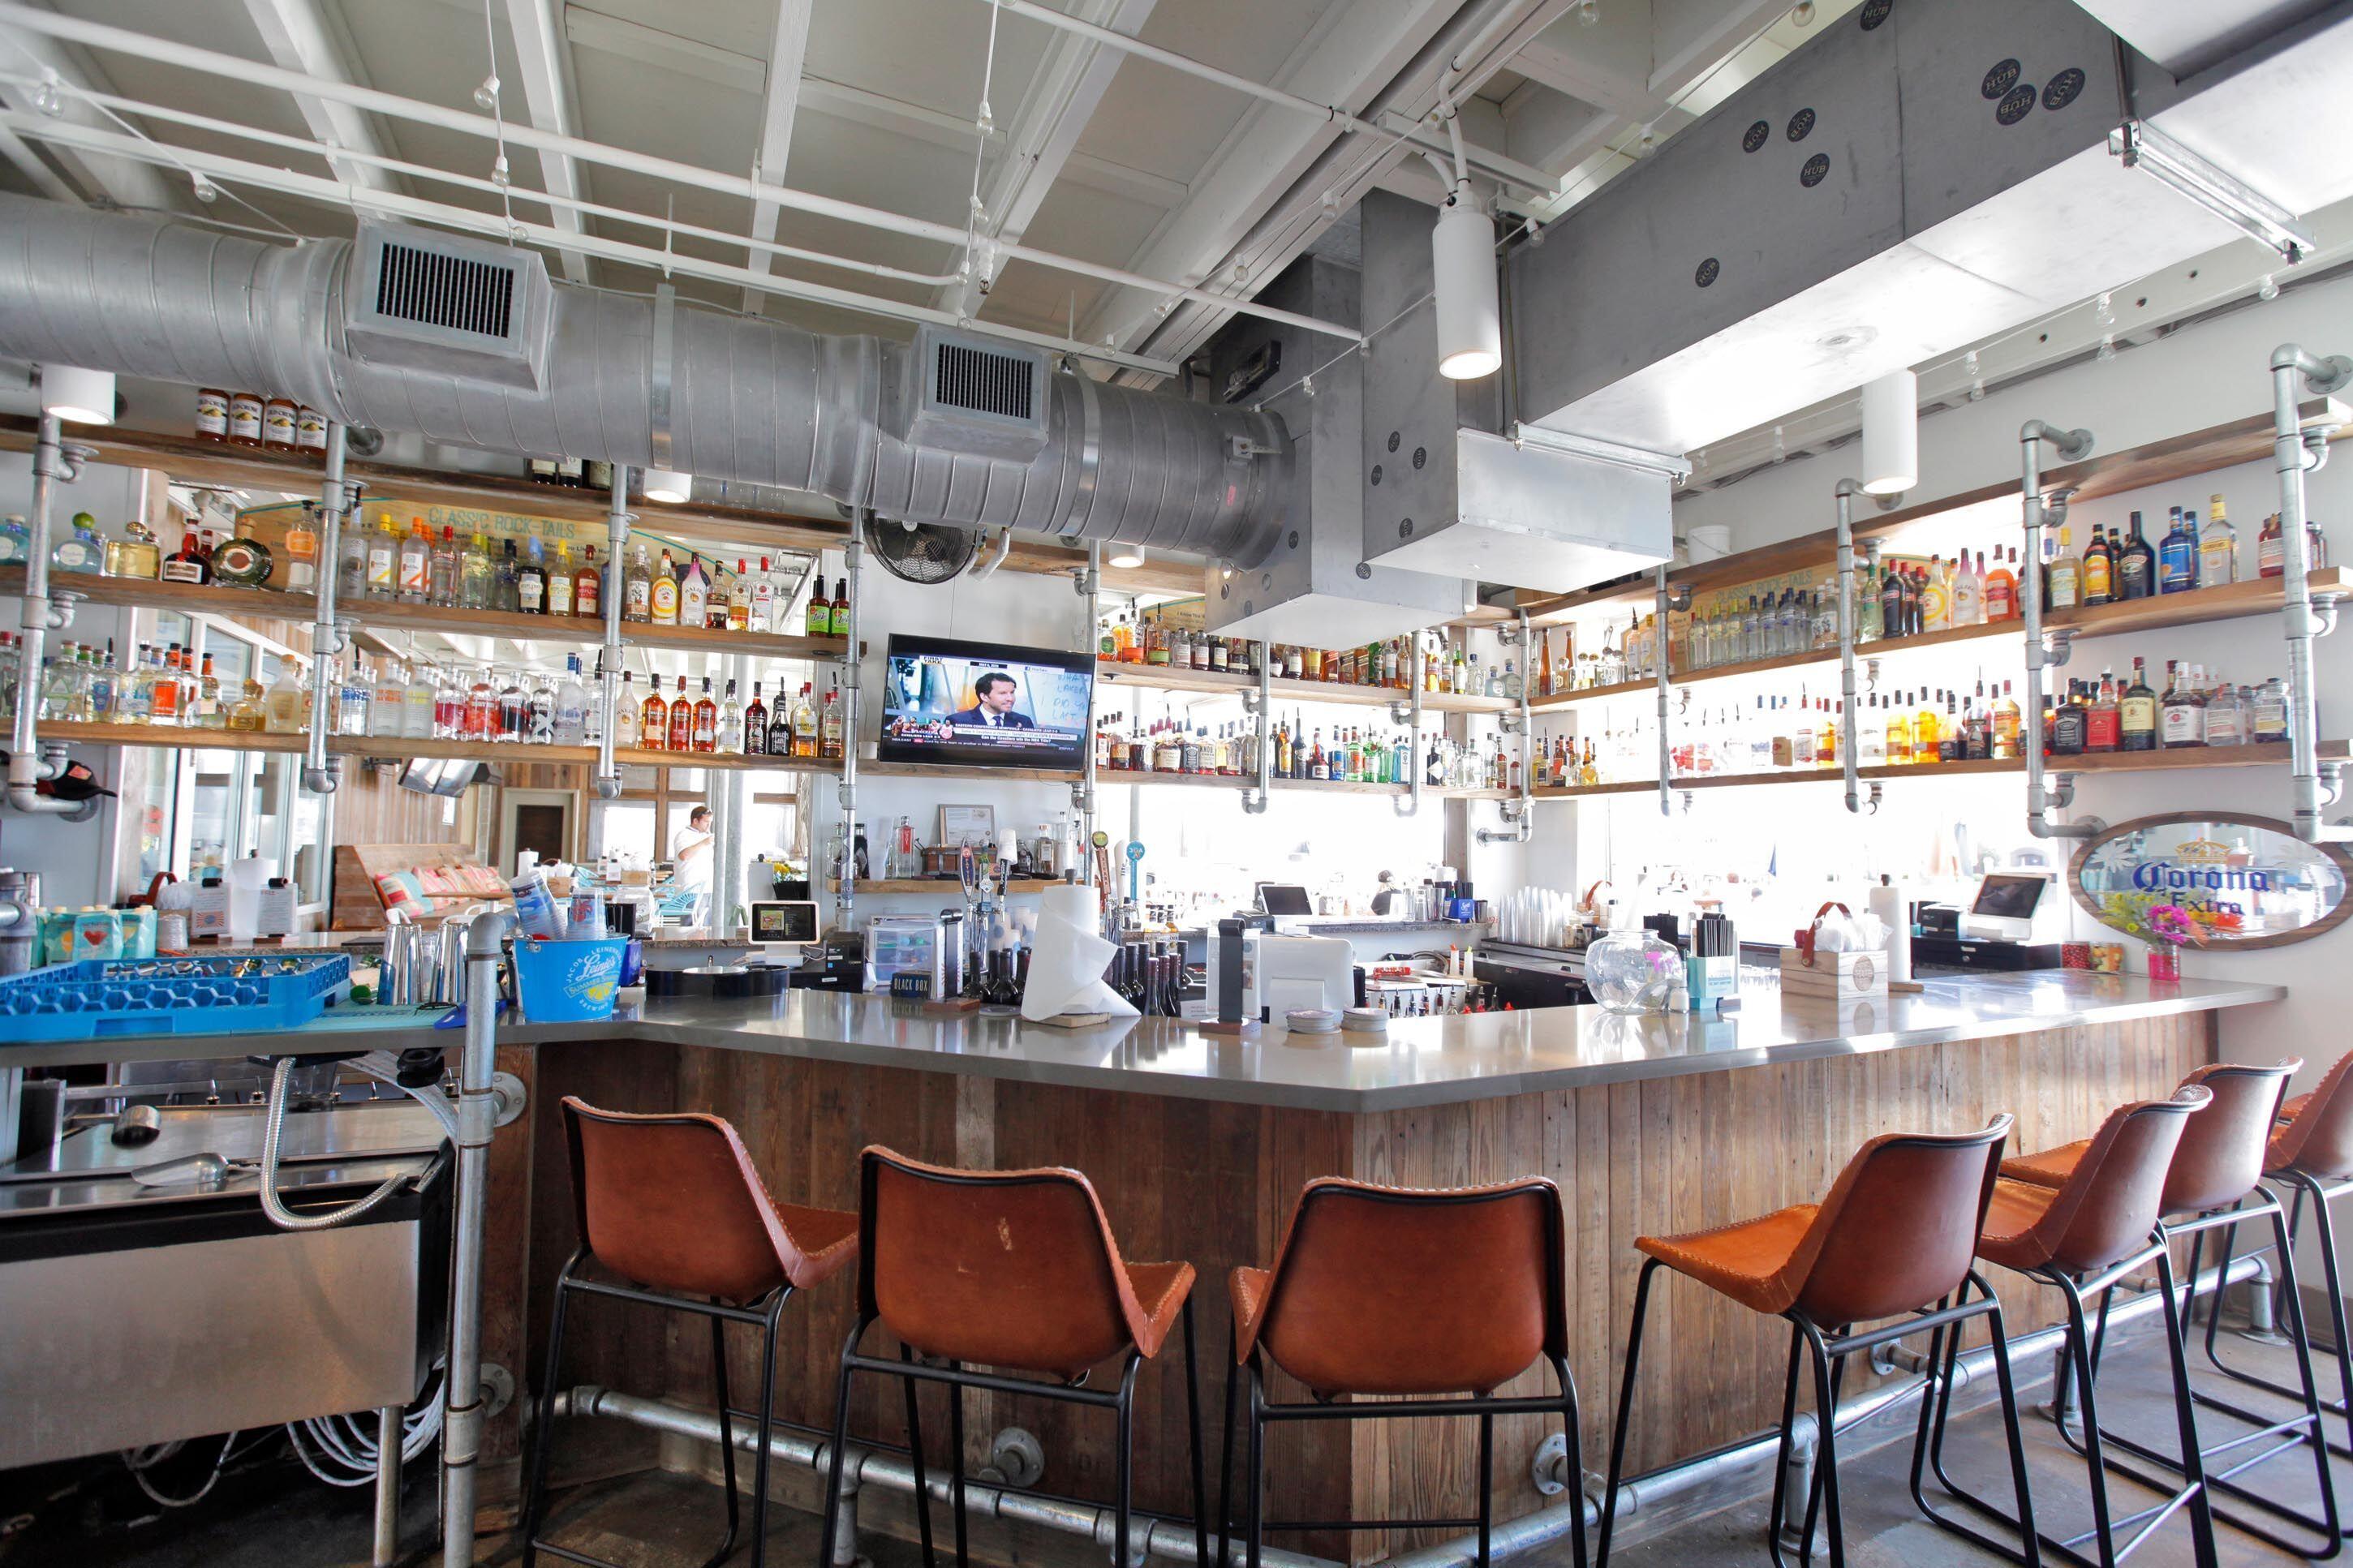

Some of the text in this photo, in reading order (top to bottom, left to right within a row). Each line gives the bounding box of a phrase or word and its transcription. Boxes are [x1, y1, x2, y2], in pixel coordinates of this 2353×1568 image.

[1863, 6, 1890, 20] HUB
[1985, 68, 2017, 92] HUB
[2049, 72, 2077, 106] HUB
[2000, 95, 2033, 115] HUB
[1745, 125, 1766, 149] HUB
[1791, 112, 1813, 139] HUB
[1804, 165, 1826, 177] HUB
[1699, 260, 1718, 284] HUB
[428, 506, 576, 539] CLASSIC ROCK-TAILS
[2132, 861, 2271, 894] Corona
[2171, 891, 2247, 916] Extra
[566, 958, 583, 984] JACOB
[893, 977, 928, 992] BLACK BOX
